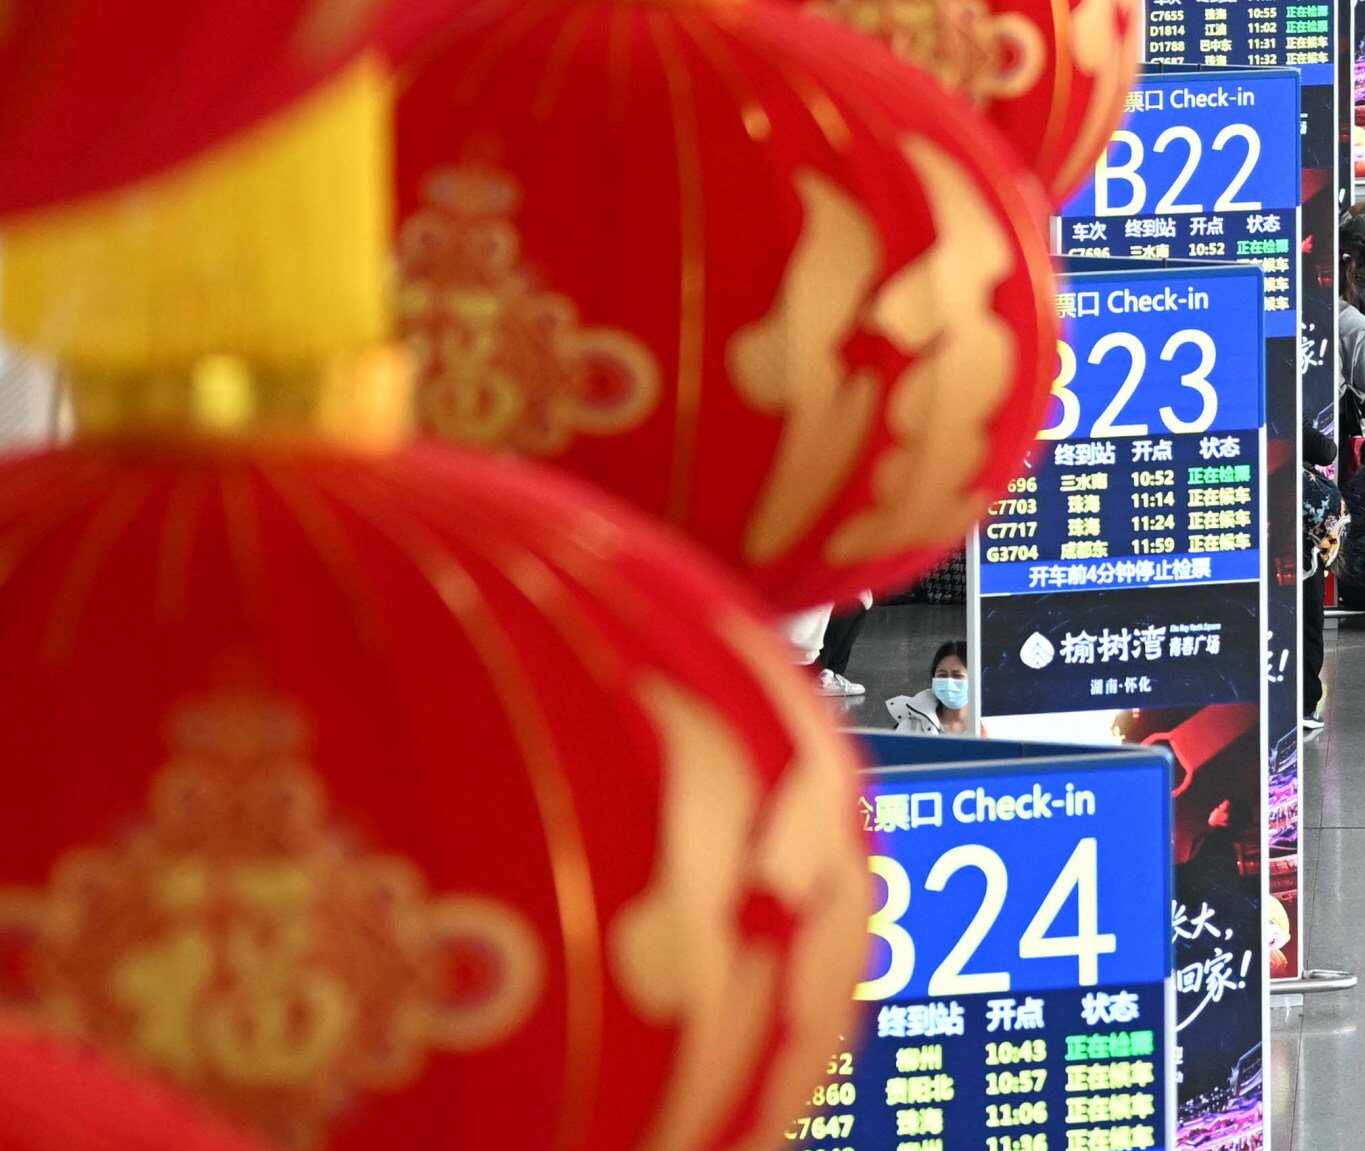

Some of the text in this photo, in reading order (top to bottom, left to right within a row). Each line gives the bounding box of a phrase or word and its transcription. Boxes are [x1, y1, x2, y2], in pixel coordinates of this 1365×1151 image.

[1169, 86, 1255, 110] Check-in
[1093, 123, 1263, 218] B22
[1073, 214, 1281, 242] 车次 终到站 开点 状态
[1189, 242, 1226, 256] 10:52
[1236, 238, 1290, 256] 正在检票
[1106, 286, 1210, 314] Check-in
[1054, 443, 1116, 466] 终到站
[1131, 440, 1173, 462] 开点
[1199, 436, 1241, 459] 状态
[1007, 465, 1251, 494] 696 三水南 10:52 正在检票
[1131, 491, 1175, 509] 11:14
[1188, 487, 1251, 507] 正在候车
[986, 521, 1038, 539] C7717
[1131, 514, 1176, 532] 11:24
[1188, 509, 1251, 530] 正在候车
[986, 532, 1251, 563] G3704 成都东 11:59 正在候车
[1028, 557, 1212, 588] 开车前4分钟停止检票
[1059, 625, 1221, 664] 榆树湾 青春广场
[952, 783, 1096, 822] Check-in
[877, 989, 1140, 1038] 终到站 开点 状态
[984, 1039, 1047, 1066] 10:43
[1064, 1030, 1154, 1061] 正在检票
[811, 1082, 856, 1106] 860
[984, 1068, 1048, 1096] 10:57
[1064, 1060, 1154, 1092] 正在候车
[984, 1101, 1048, 1128] 11:06
[1064, 1092, 1154, 1124] 正在候车
